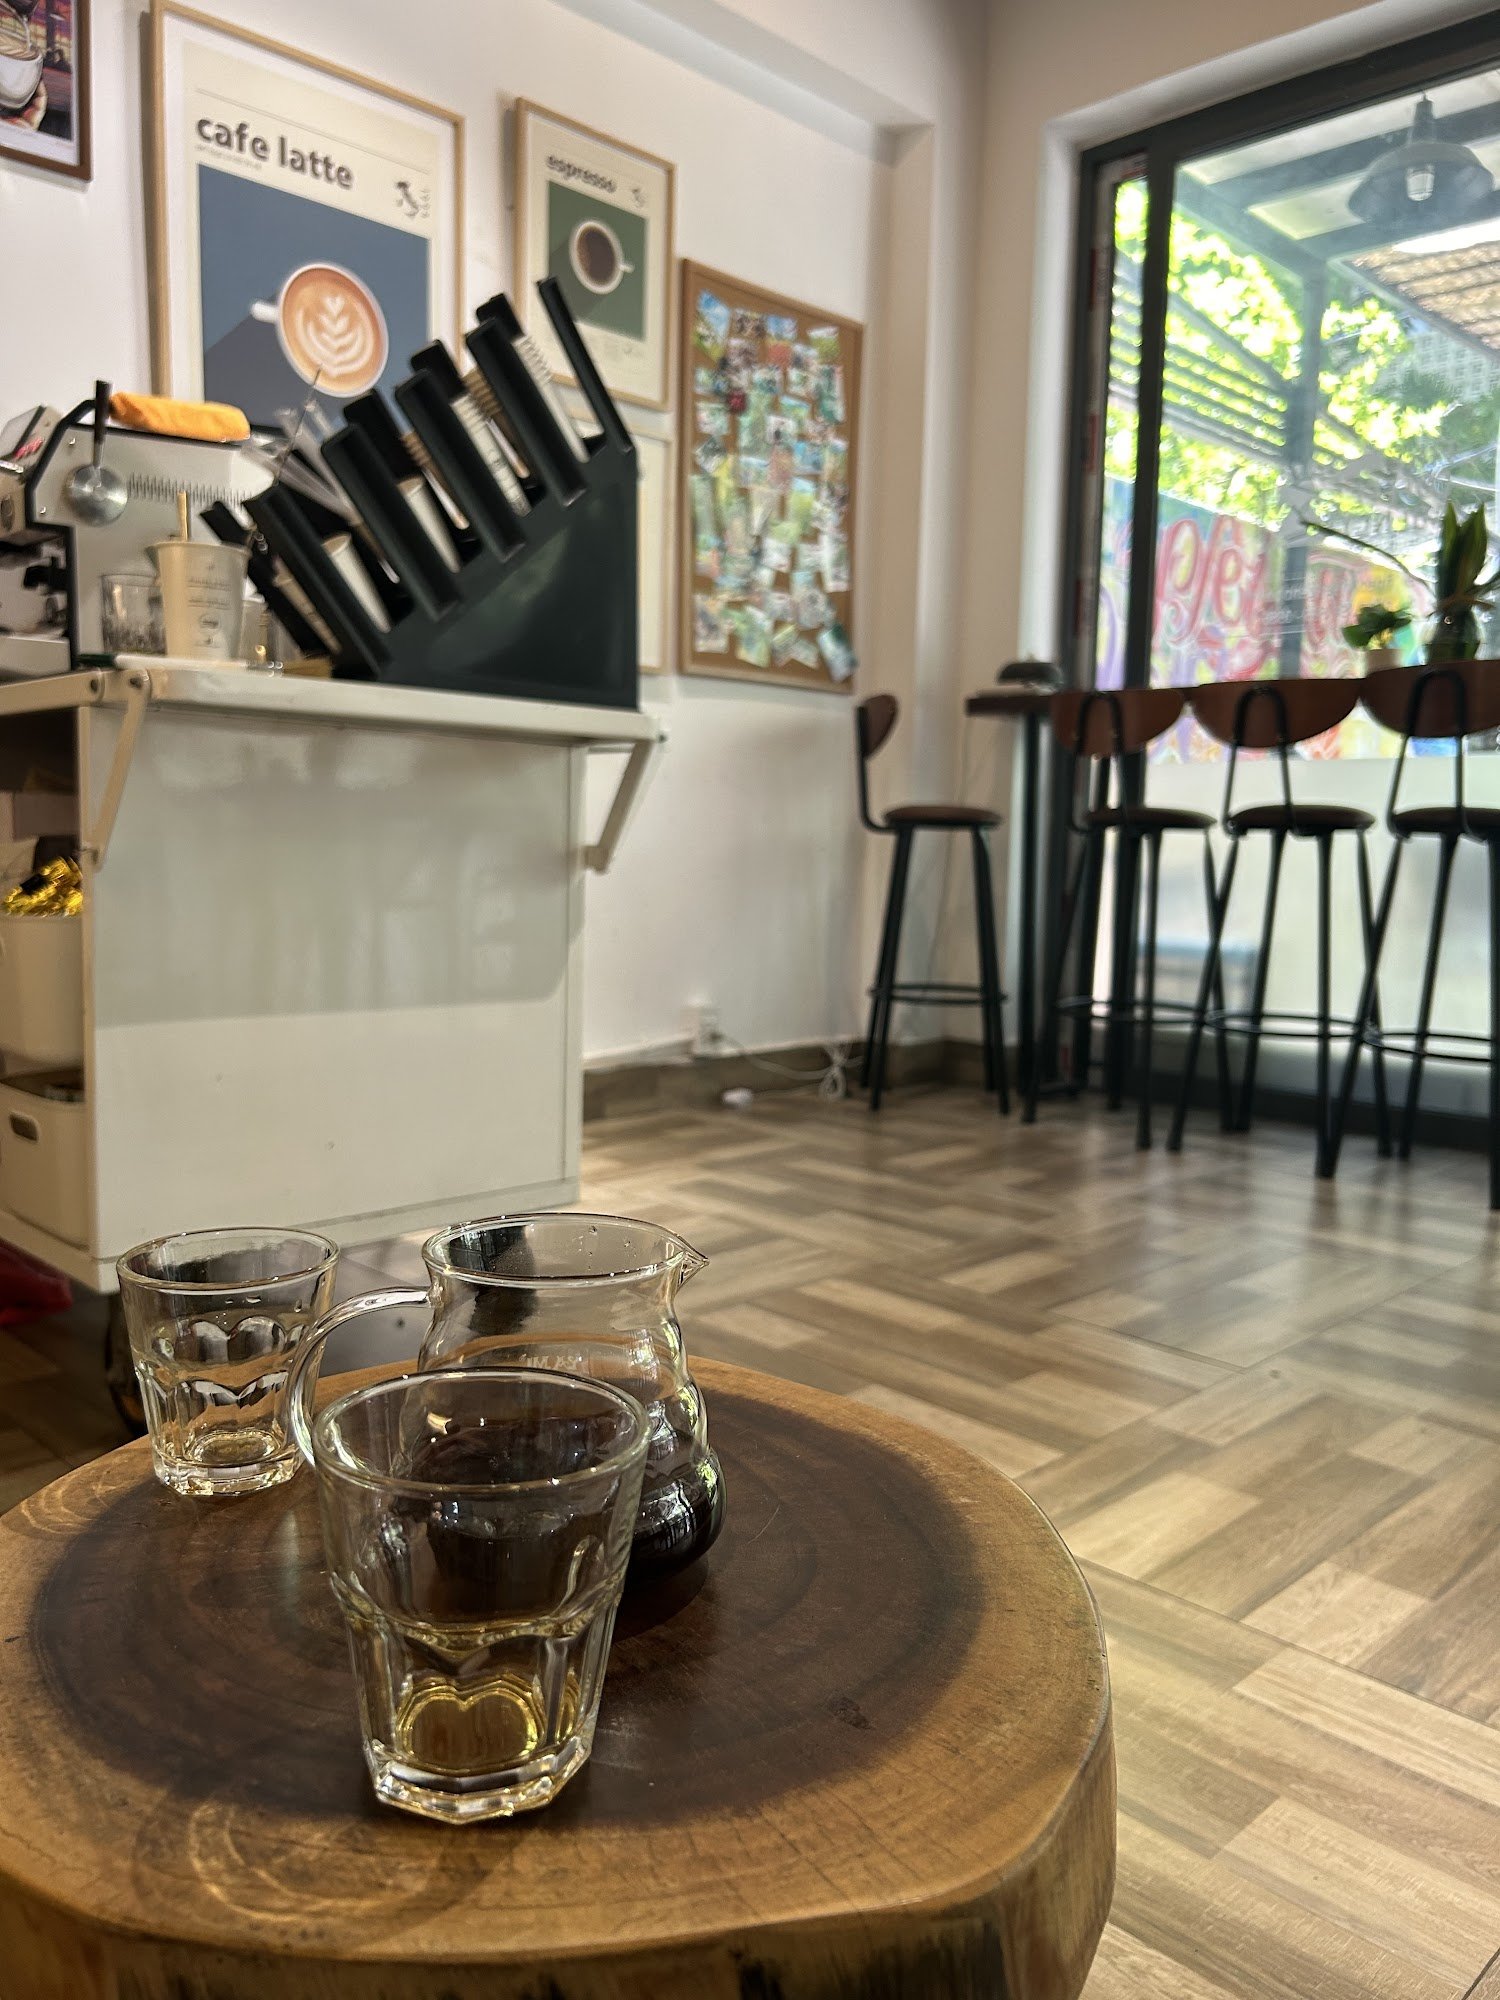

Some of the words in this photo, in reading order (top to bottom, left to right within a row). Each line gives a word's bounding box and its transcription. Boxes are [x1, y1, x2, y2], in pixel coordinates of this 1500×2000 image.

[197, 118, 269, 161] cafe
[279, 134, 353, 190] latte
[547, 155, 617, 193] espresso
